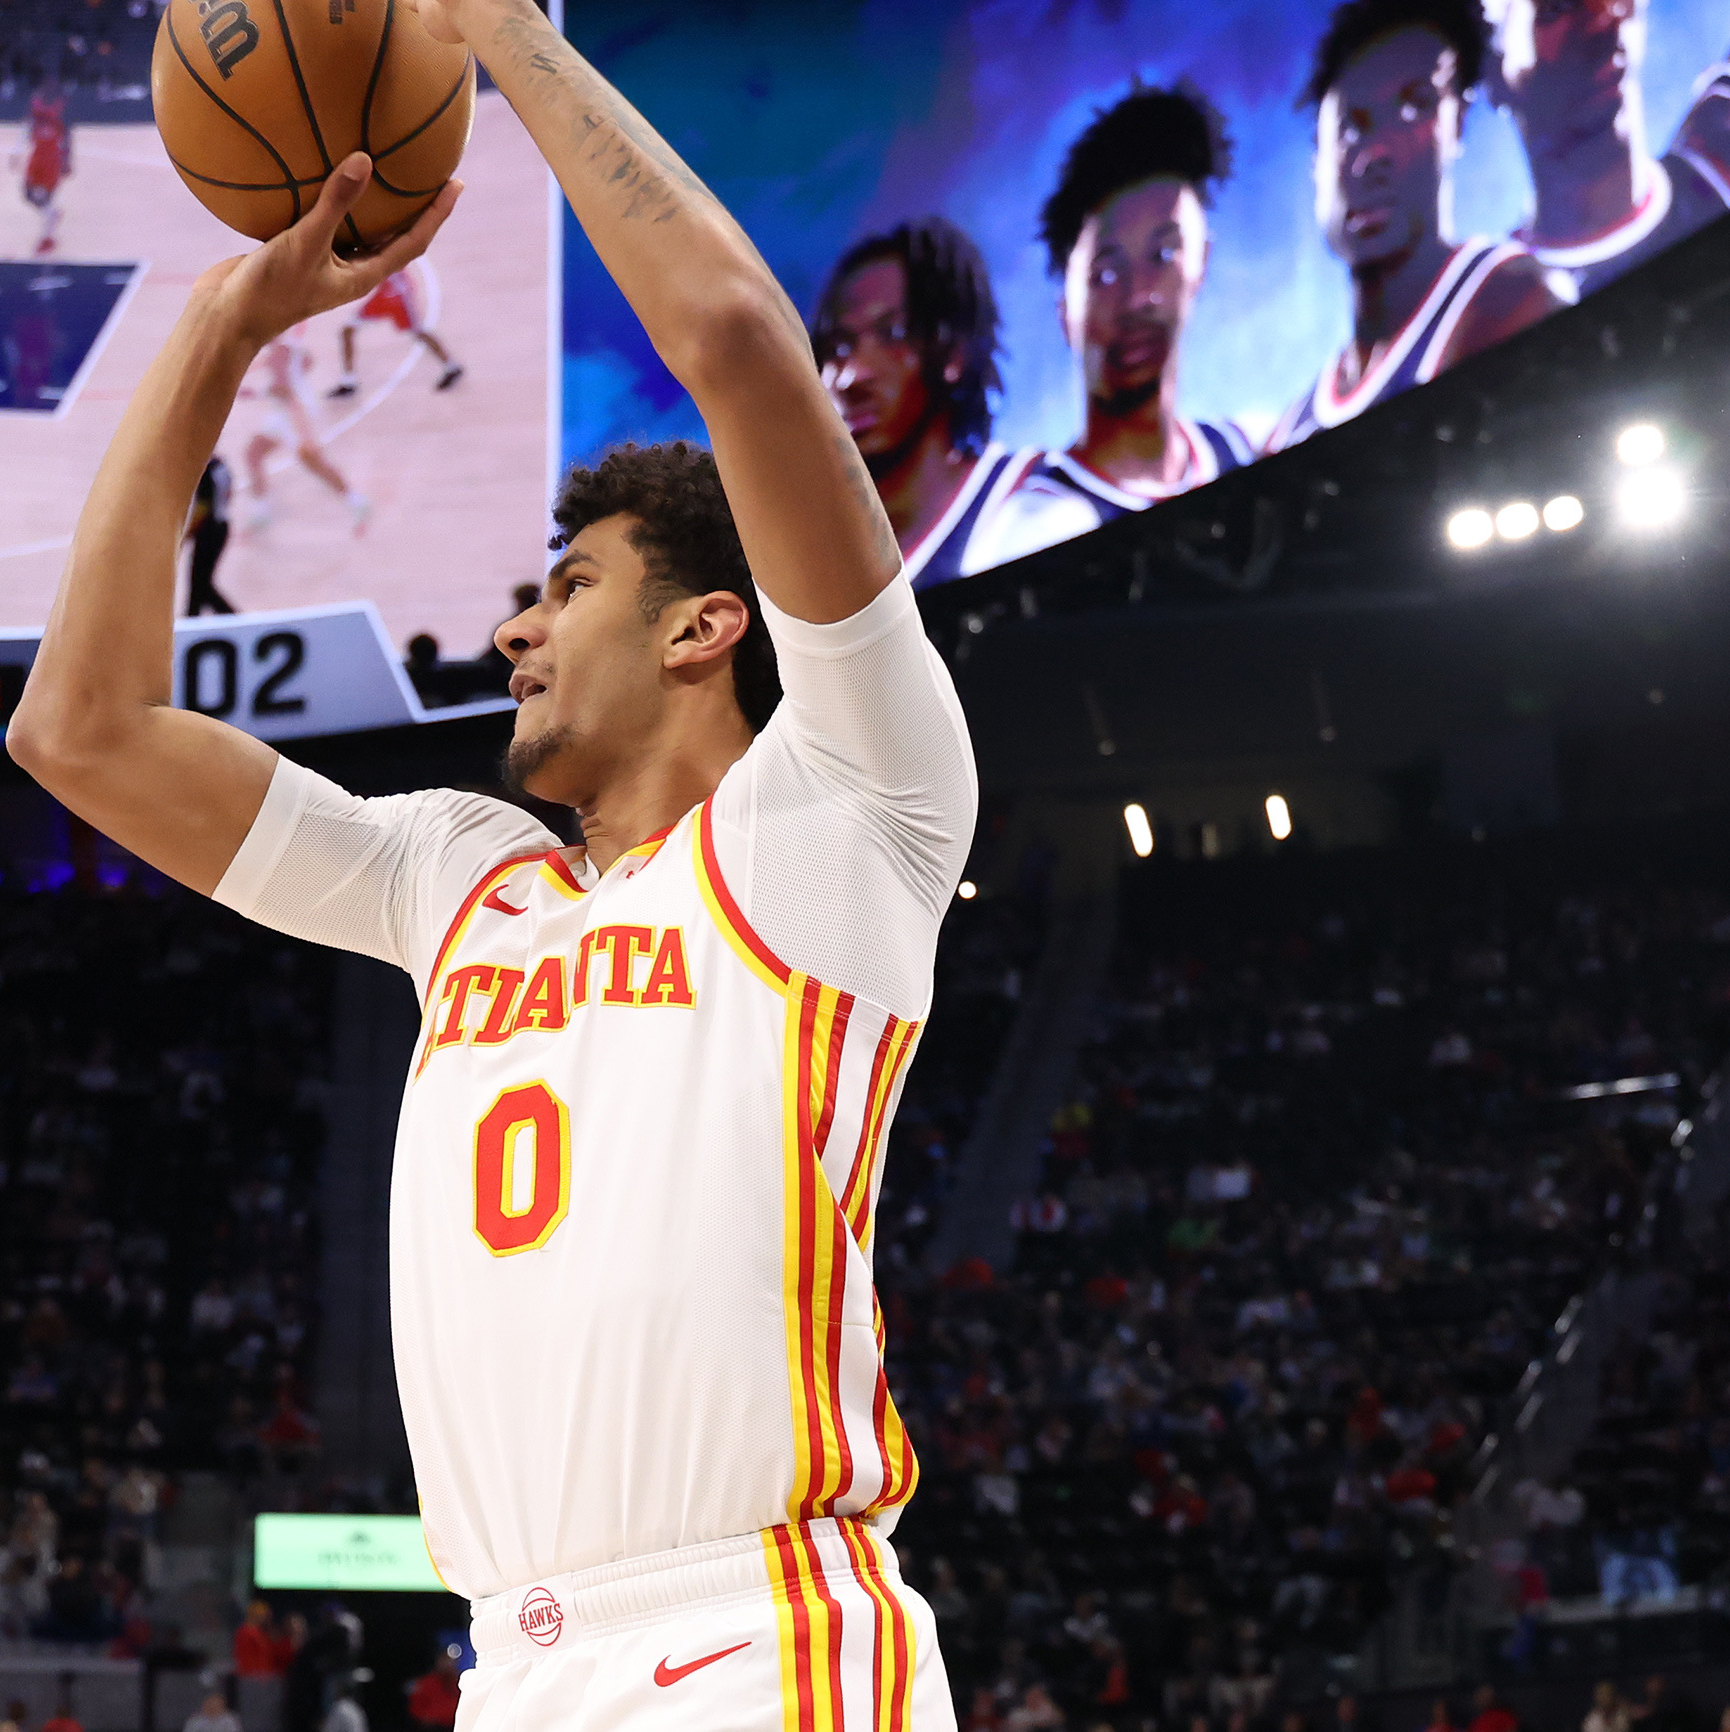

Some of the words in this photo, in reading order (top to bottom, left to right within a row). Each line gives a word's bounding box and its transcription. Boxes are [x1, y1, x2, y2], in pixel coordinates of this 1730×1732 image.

[185, 630, 305, 720] 02
[414, 923, 696, 1084] TLATA
[472, 1079, 571, 1257] 0
[518, 1602, 564, 1632] HAWKS
